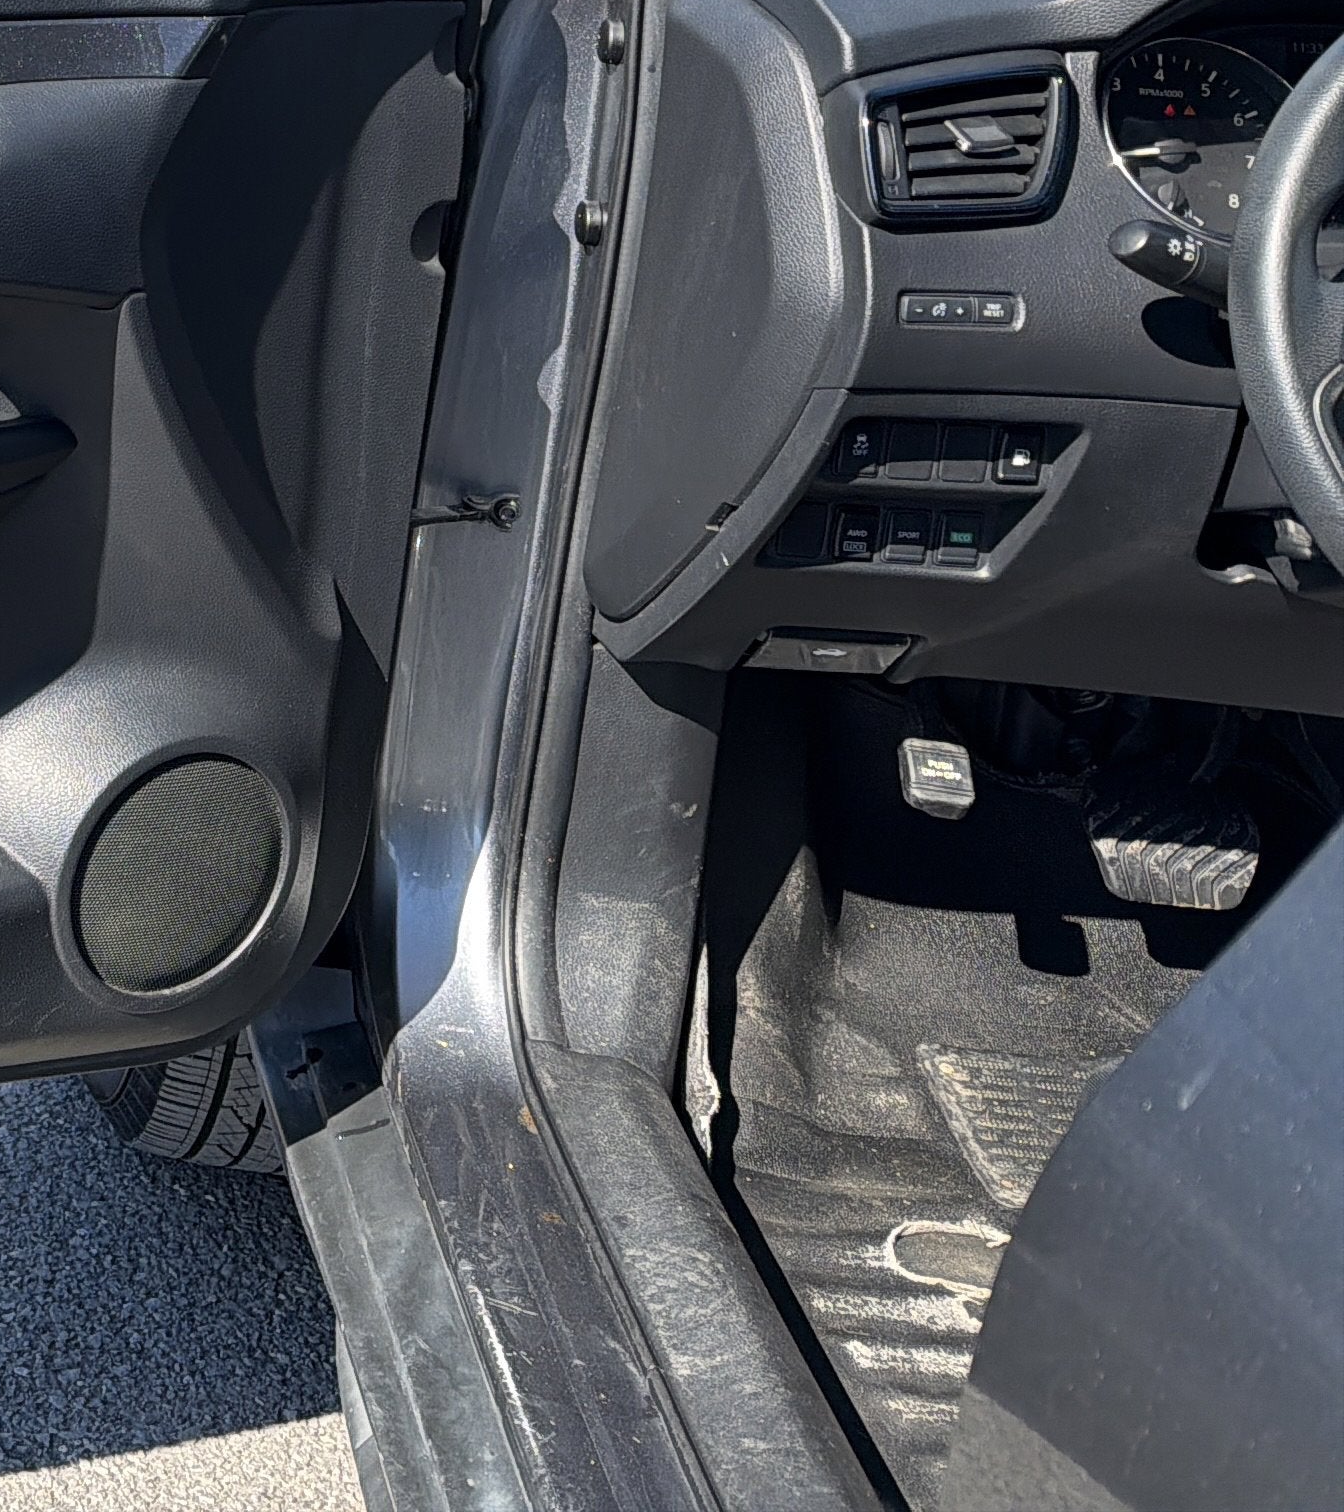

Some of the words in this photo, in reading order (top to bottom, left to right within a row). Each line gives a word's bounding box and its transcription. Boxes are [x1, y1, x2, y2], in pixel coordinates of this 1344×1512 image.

[1154, 68, 1165, 82] 4
[1111, 77, 1121, 92] 3
[1201, 83, 1211, 98] 5
[1233, 112, 1244, 127] 6
[1244, 154, 1255, 169] 7
[1228, 193, 1240, 209] 8
[897, 530, 921, 539] SPORT
